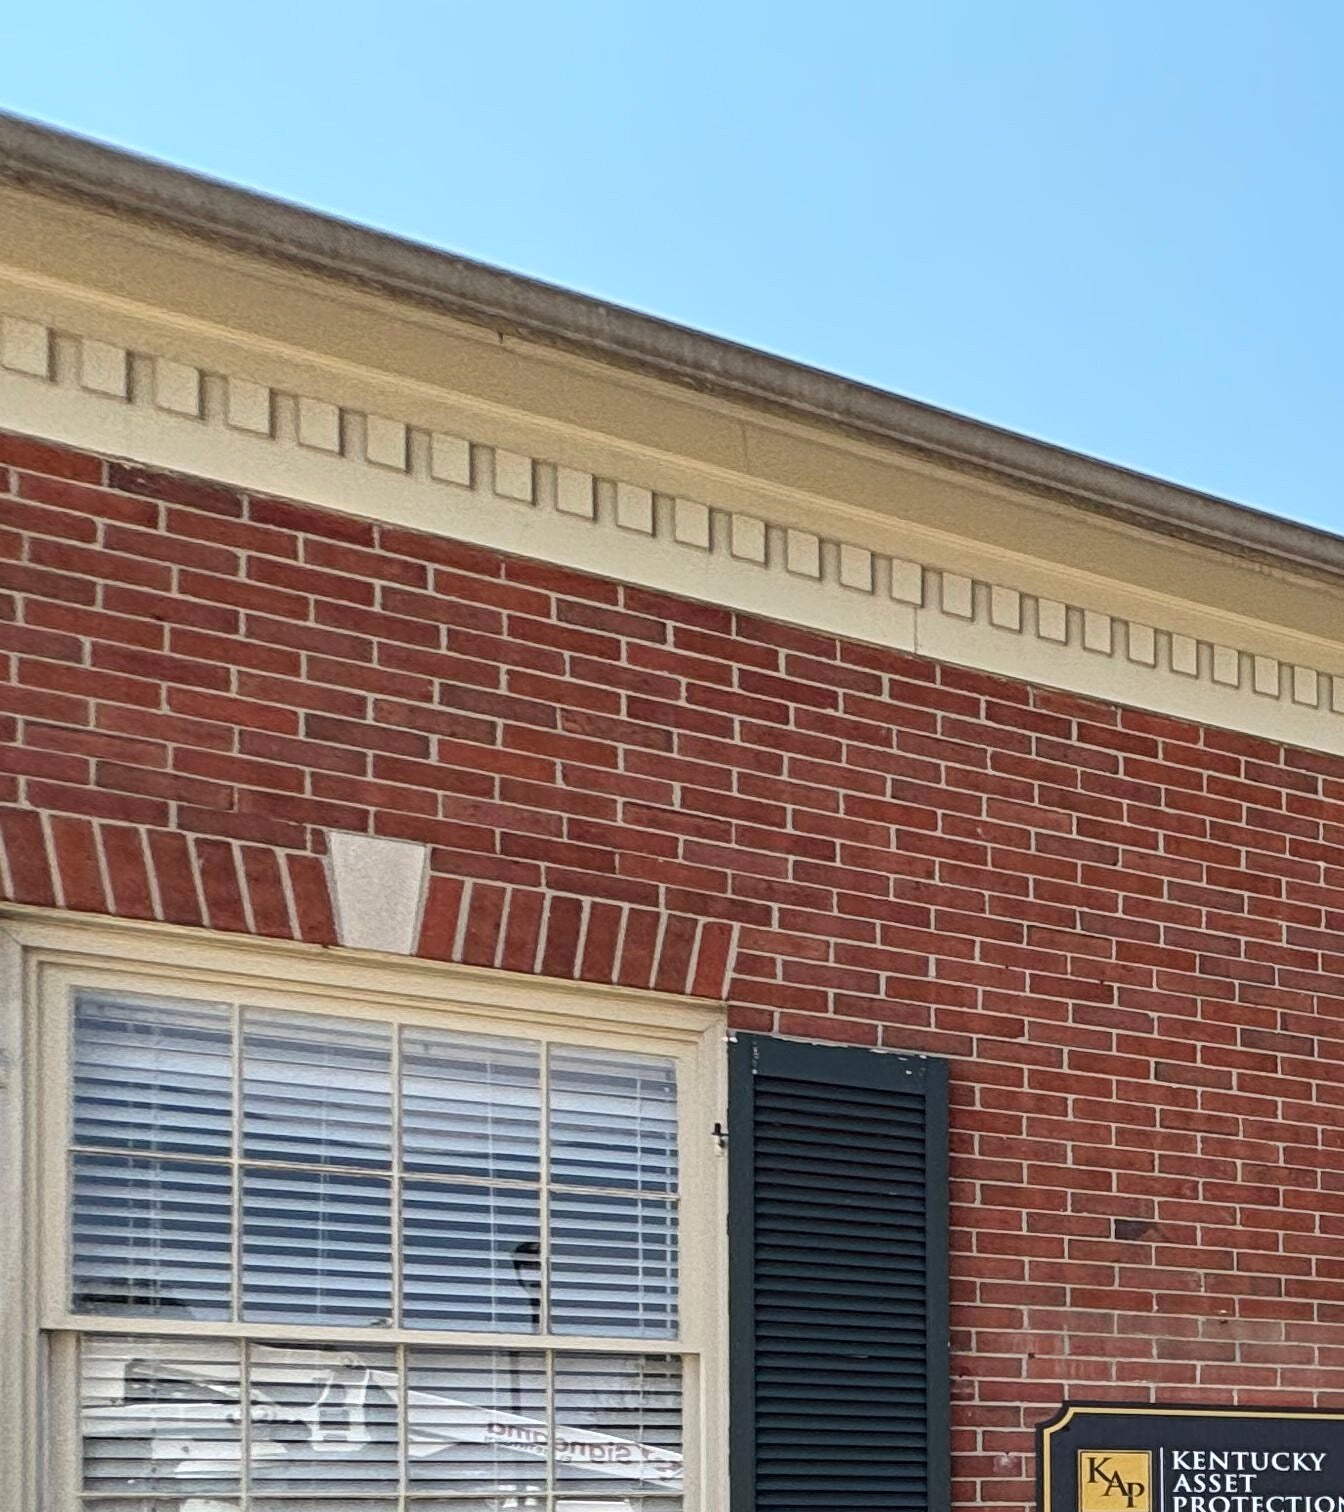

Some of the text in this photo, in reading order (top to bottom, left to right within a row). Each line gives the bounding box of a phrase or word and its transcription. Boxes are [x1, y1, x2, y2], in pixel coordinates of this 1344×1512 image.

[1171, 1450, 1327, 1472] KENTUCKY
[1086, 1456, 1145, 1508] KAP
[1172, 1473, 1258, 1494] ASSET
